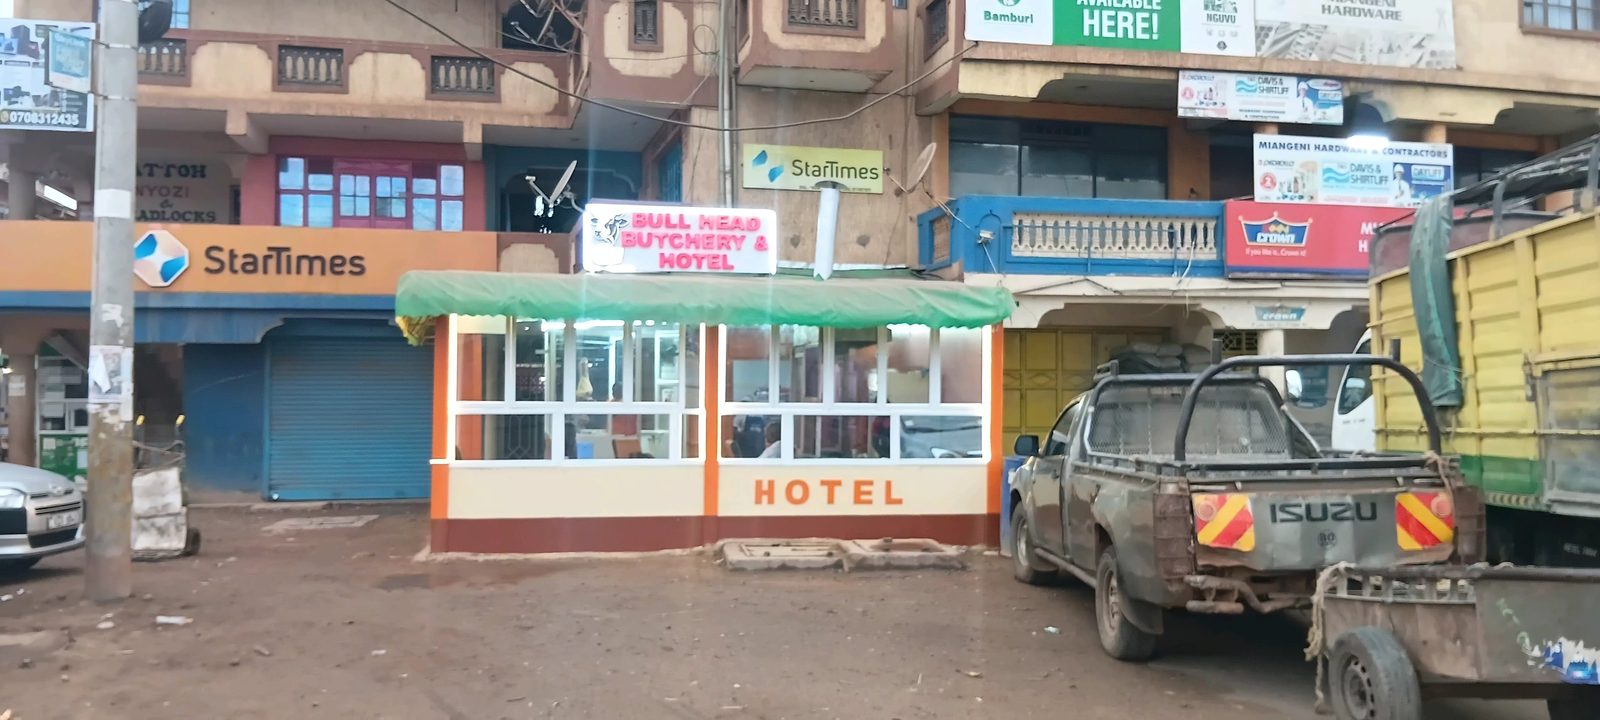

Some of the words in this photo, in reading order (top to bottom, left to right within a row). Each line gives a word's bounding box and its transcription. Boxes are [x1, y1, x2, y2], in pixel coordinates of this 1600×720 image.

[1076, 0, 1162, 10] LABLE
[1321, 4, 1402, 21] HARDWARE
[1327, 0, 1397, 8] GENI
[983, 10, 1034, 24] Bamburi
[1083, 9, 1158, 40] HERE!
[1206, 13, 1236, 24] NGUVU
[10, 110, 79, 126] 0708312435
[1258, 141, 1310, 151] MIANGENI
[1382, 148, 1447, 159] CONTRACTORS
[792, 159, 879, 180] StarTimes
[632, 213, 691, 230] BULL
[699, 214, 761, 232] HEAD
[621, 232, 746, 250] BUTCHERY
[754, 236, 769, 251] &
[203, 245, 366, 276] StarTimes
[659, 252, 734, 271] HOTEL
[754, 479, 904, 506] HOTEL
[1270, 501, 1377, 523] ISUZU
